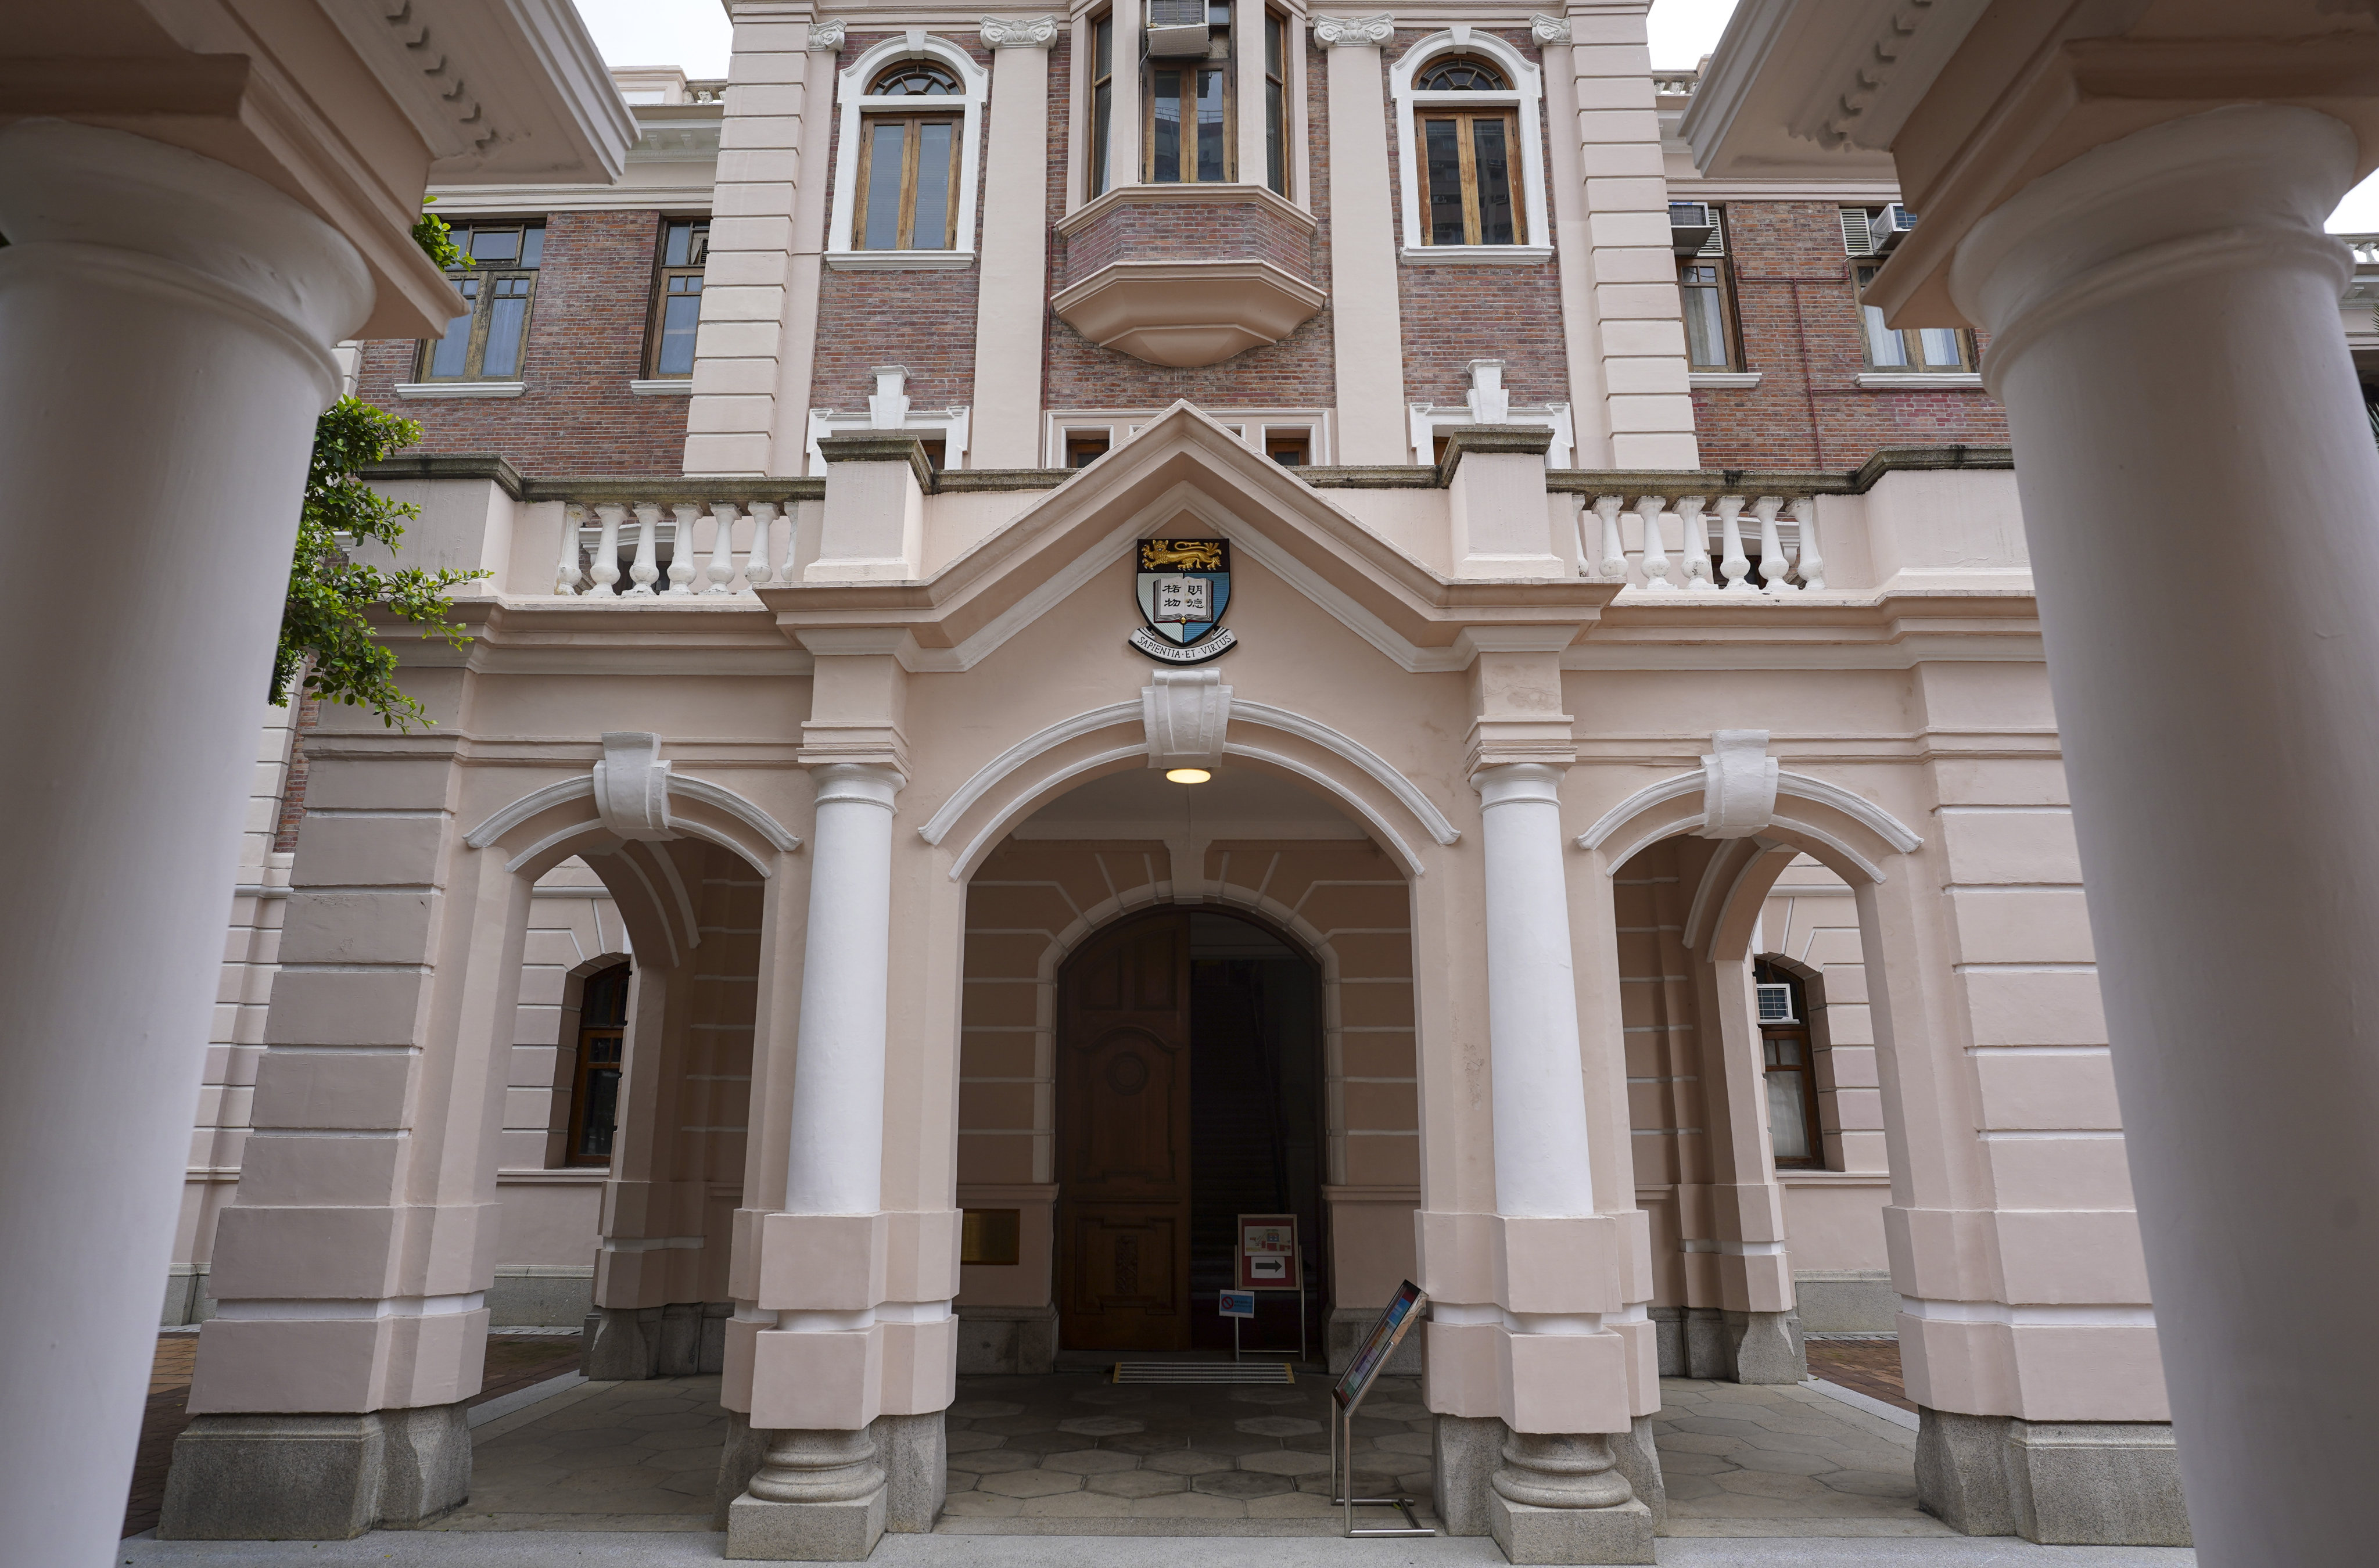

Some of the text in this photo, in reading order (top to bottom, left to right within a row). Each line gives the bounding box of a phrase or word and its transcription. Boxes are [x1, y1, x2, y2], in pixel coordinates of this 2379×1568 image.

[1137, 634, 1232, 658] SAPIENTIA ET VIRTUS
